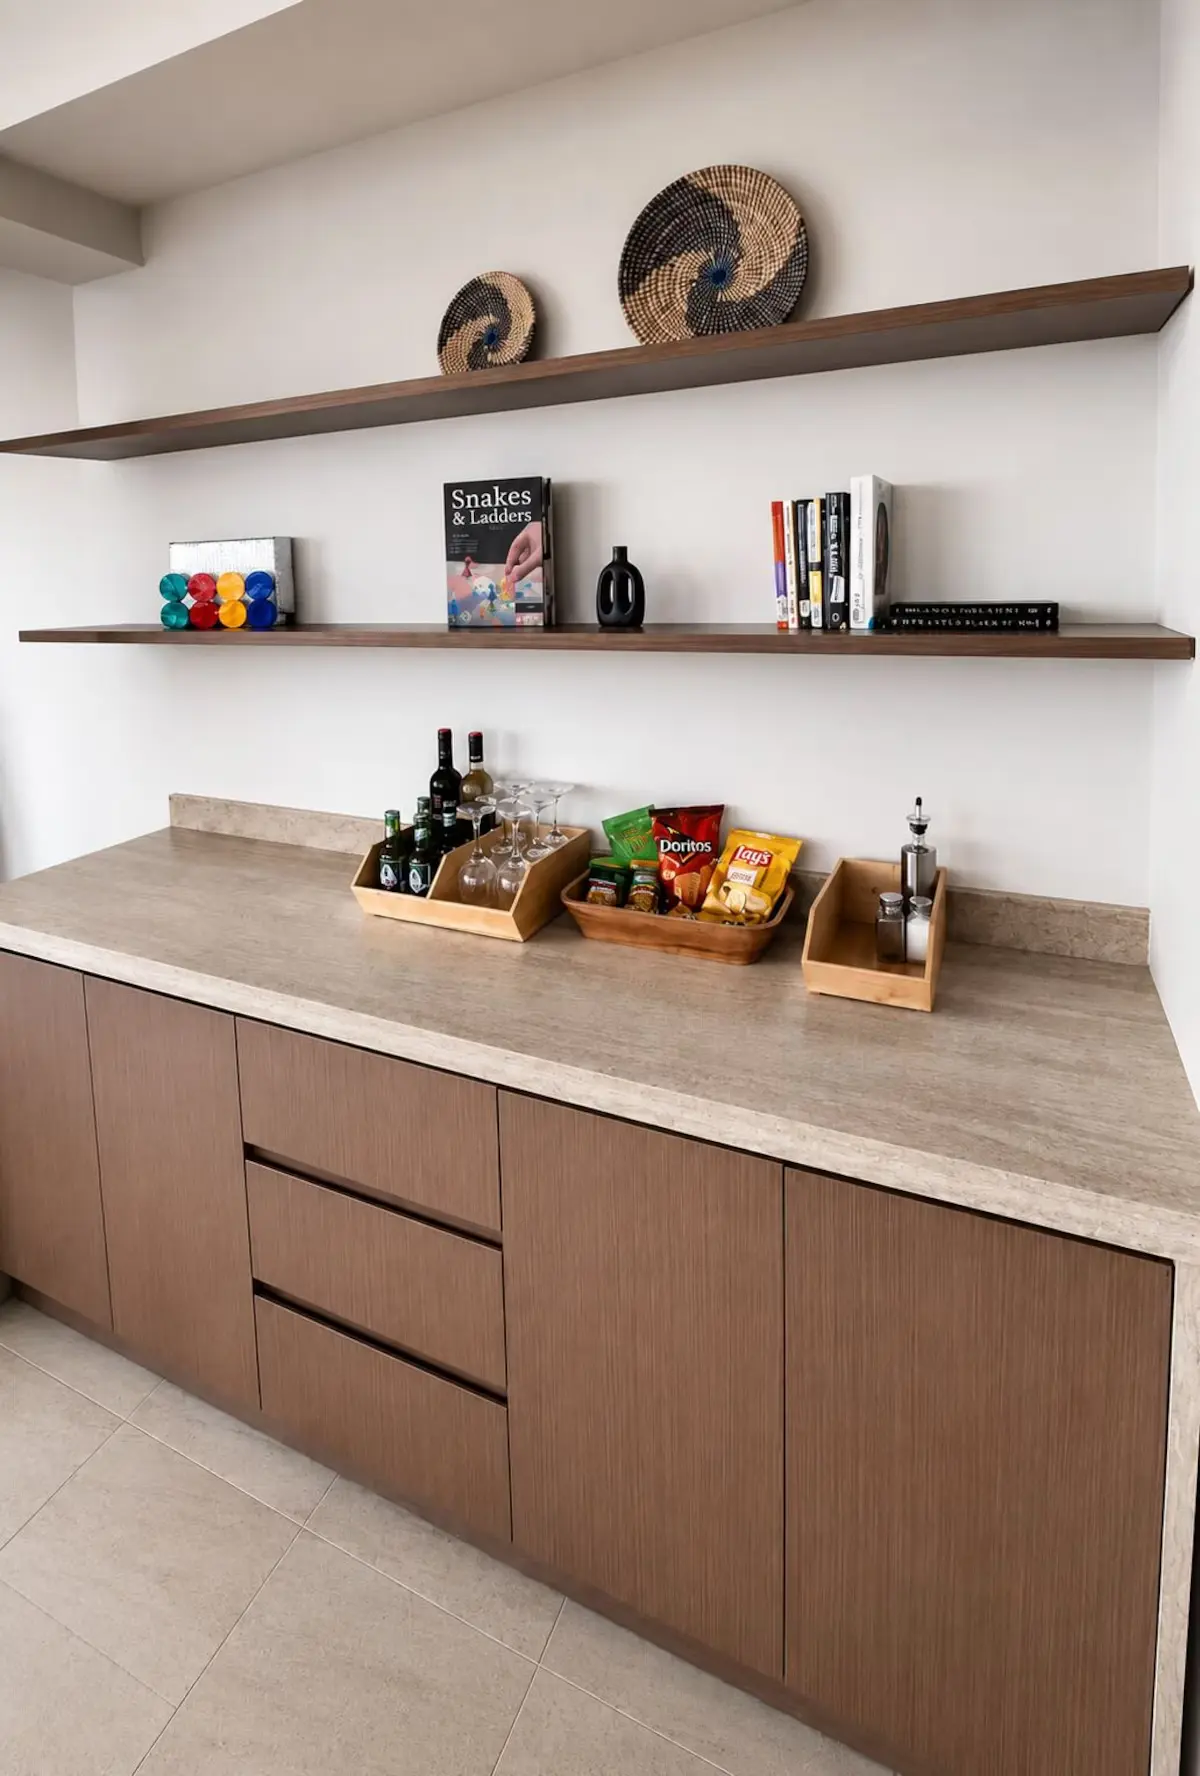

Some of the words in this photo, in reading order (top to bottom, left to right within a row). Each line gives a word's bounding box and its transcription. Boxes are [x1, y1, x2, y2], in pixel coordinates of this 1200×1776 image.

[451, 485, 532, 509] Snakes
[452, 511, 466, 526] &
[469, 508, 532, 525] Ladders
[660, 839, 712, 853] Doritos
[735, 844, 772, 865] Lay's
